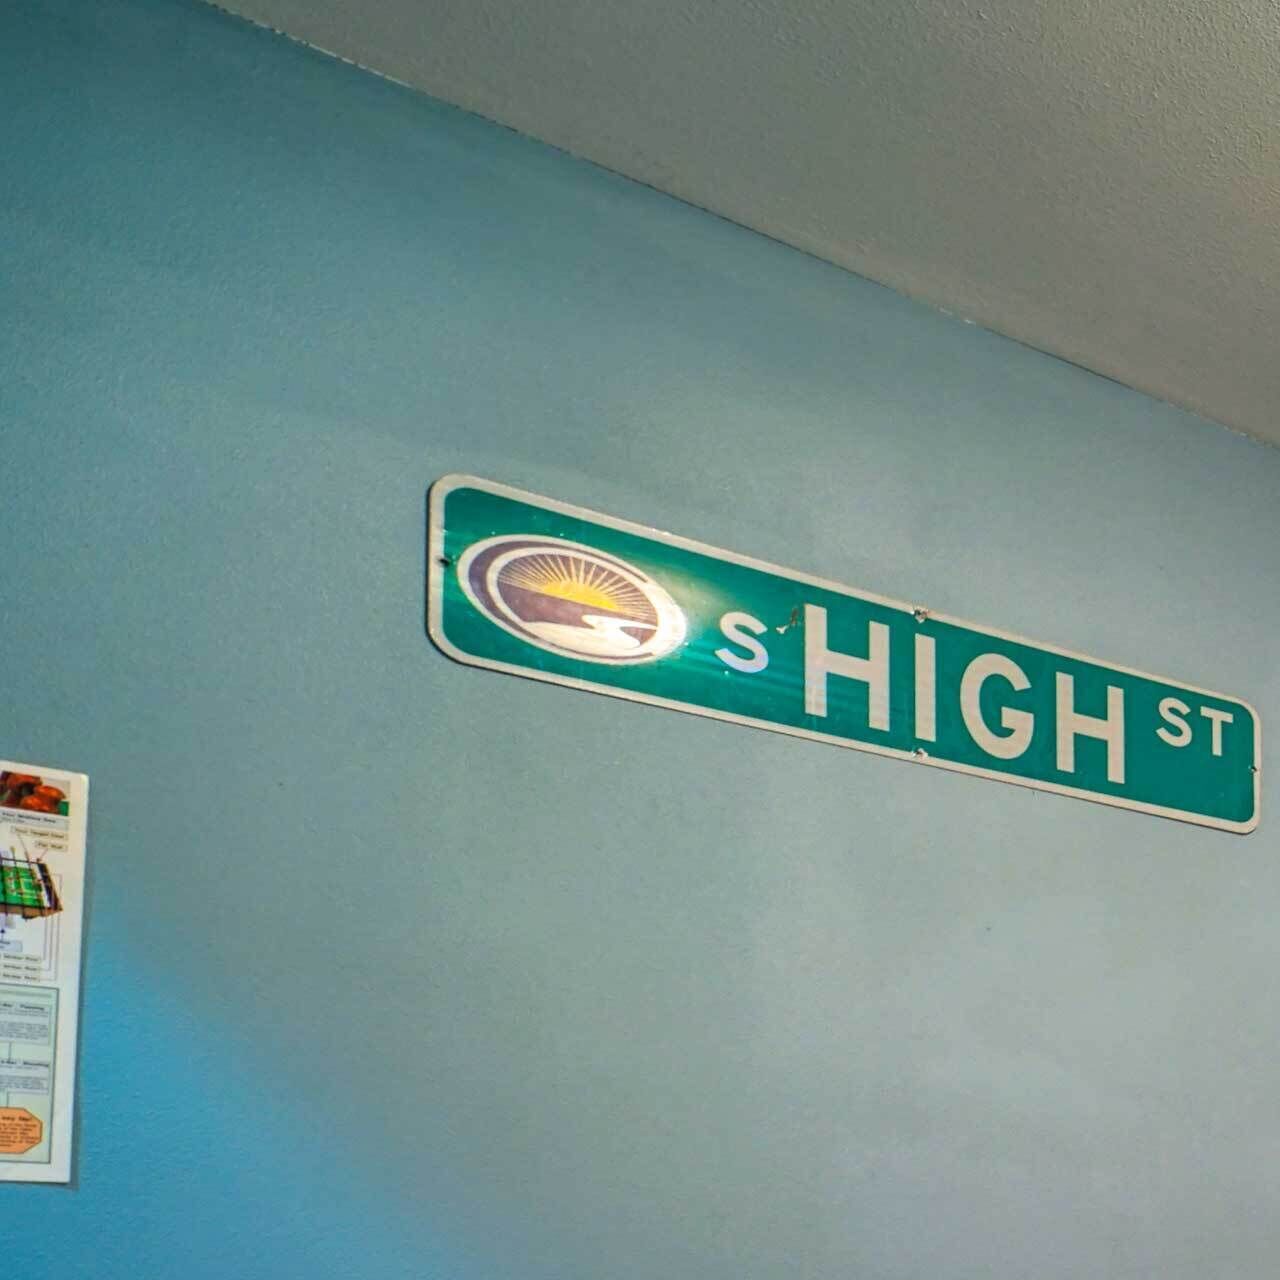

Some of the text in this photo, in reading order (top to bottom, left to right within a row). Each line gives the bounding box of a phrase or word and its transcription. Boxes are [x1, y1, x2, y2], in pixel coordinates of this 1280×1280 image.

[714, 604, 1234, 784] S HIGH ST
